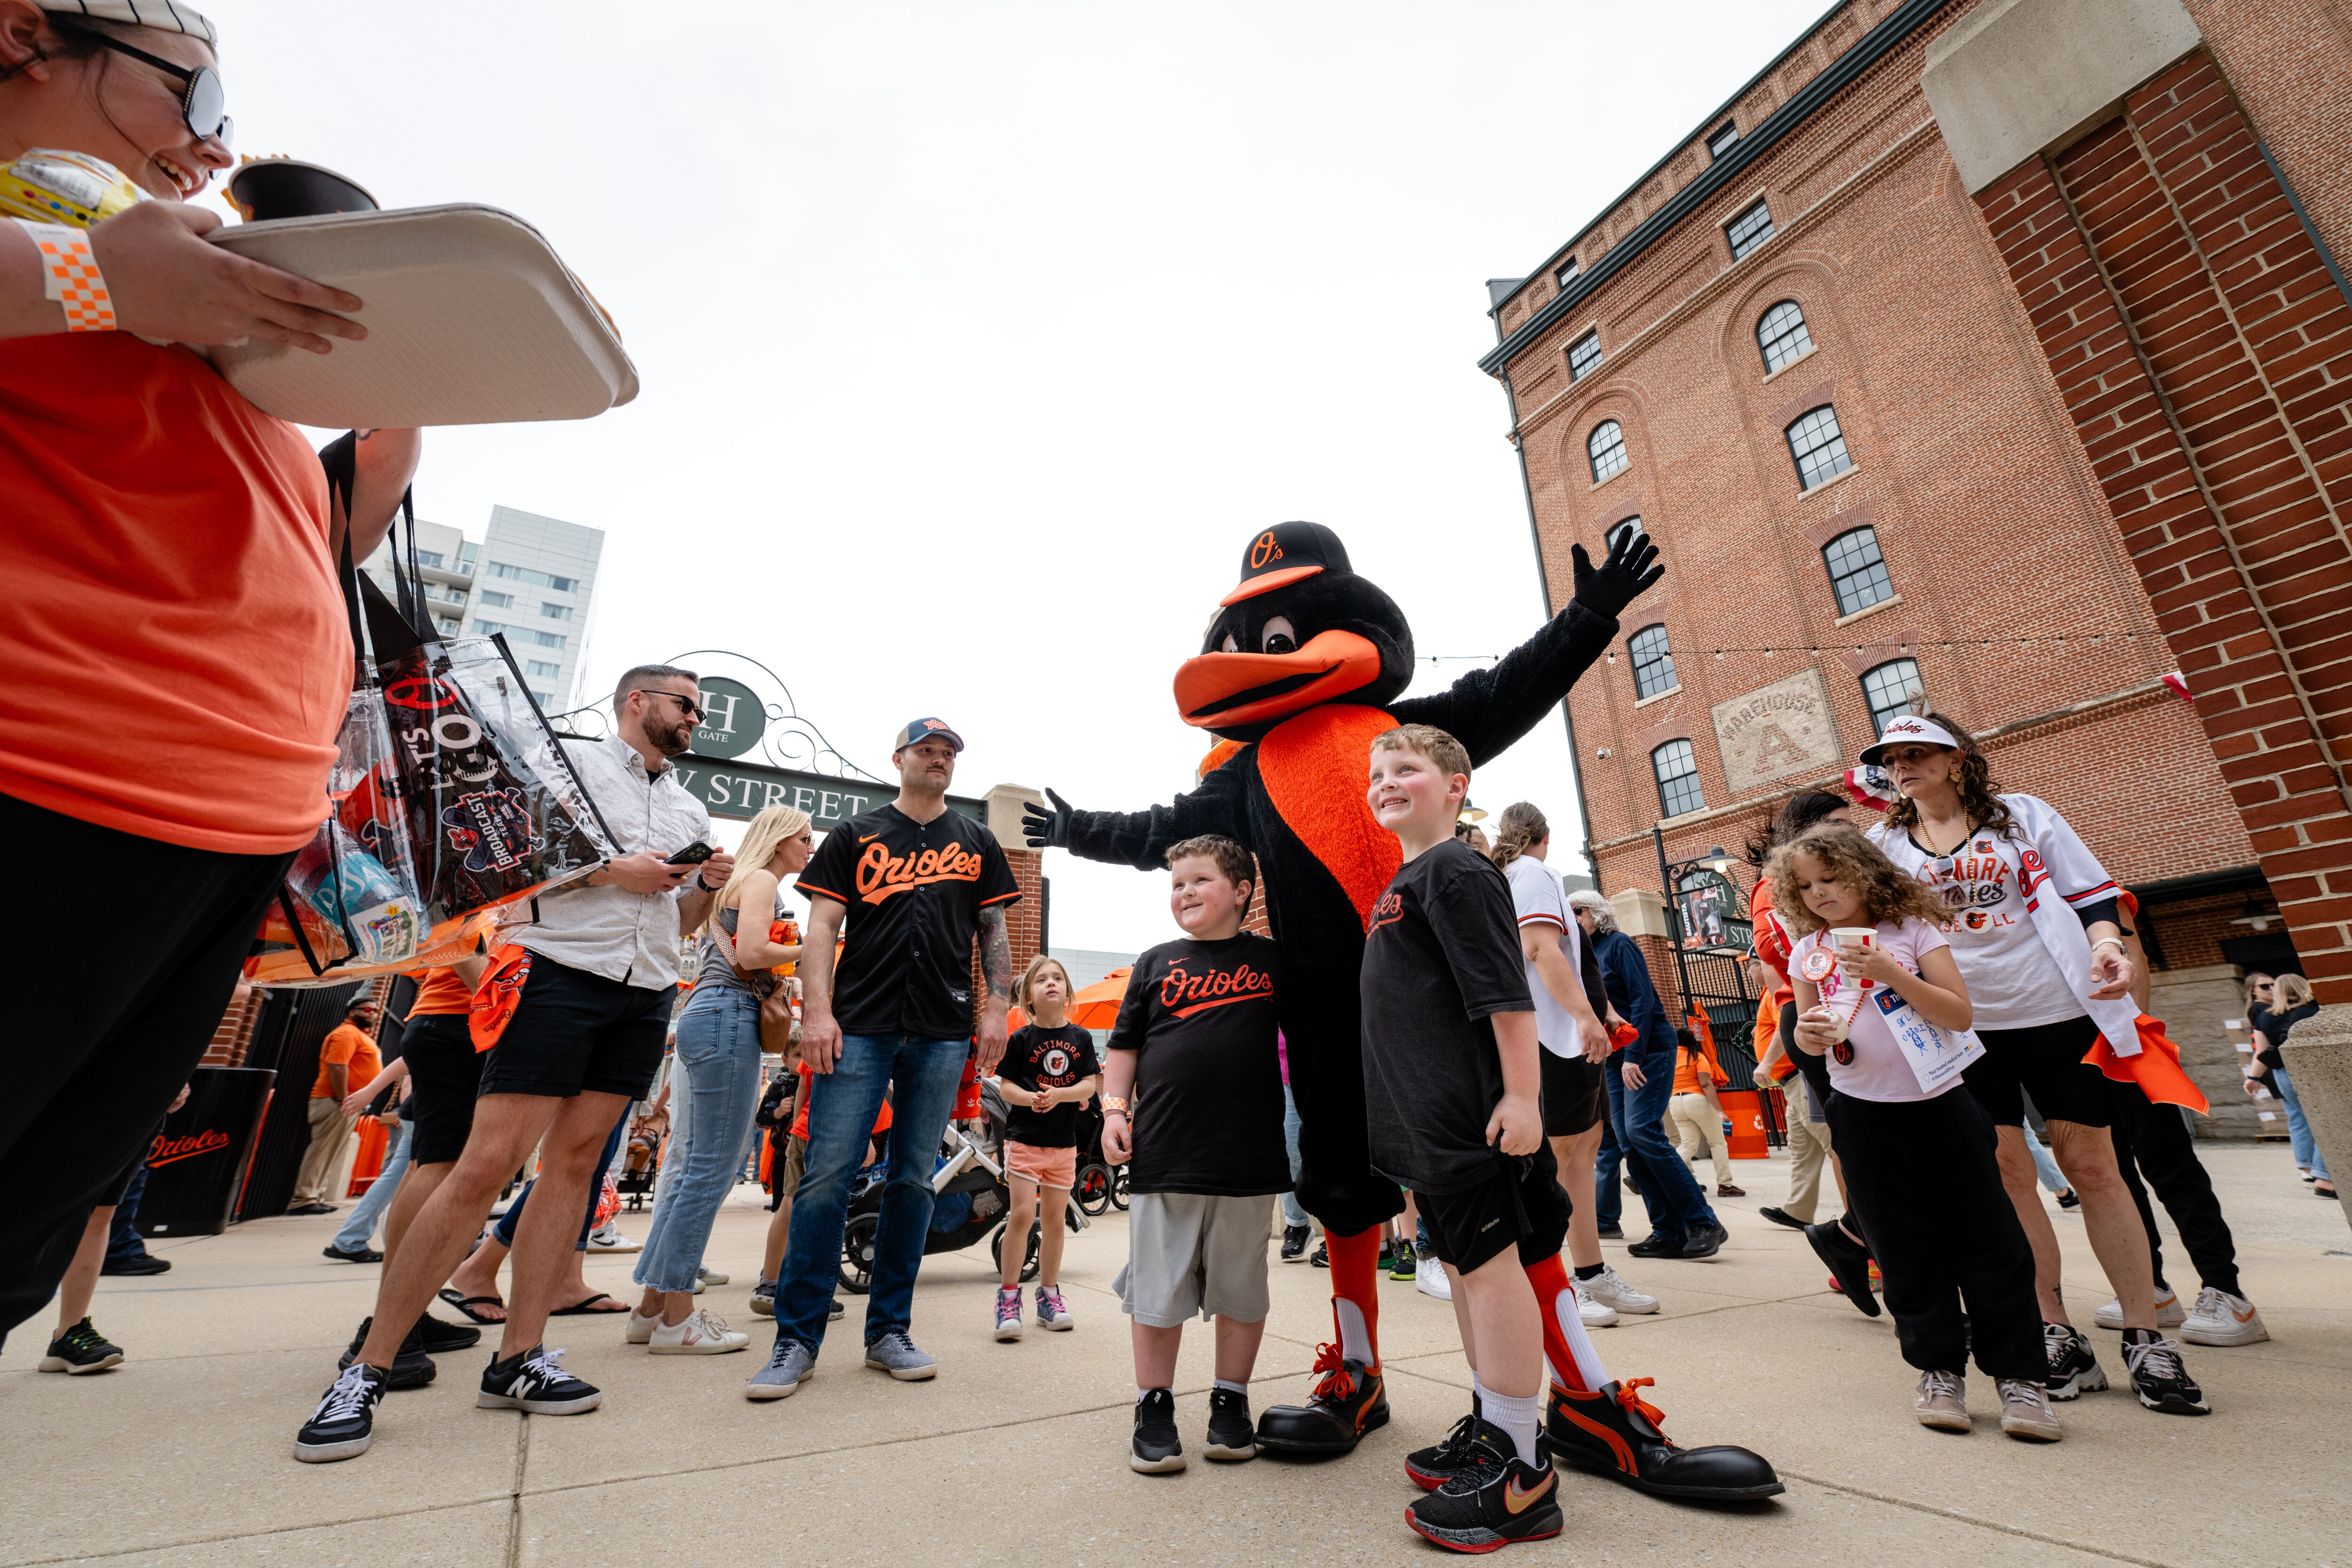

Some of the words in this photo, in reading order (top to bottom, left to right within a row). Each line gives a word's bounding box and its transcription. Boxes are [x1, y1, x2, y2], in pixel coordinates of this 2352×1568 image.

[1251, 531, 1283, 569] O's
[699, 691, 741, 733] H
[699, 731, 728, 742] GATE
[1753, 722, 1811, 775] A
[707, 774, 868, 820] STREET
[467, 797, 514, 866] BROADCAST
[493, 814, 509, 837] TEAM
[856, 842, 982, 899] Orioles
[1681, 903, 1692, 937] BAUTISTA
[1731, 925, 1754, 944] STR
[1806, 947, 1819, 956] TODAY
[1824, 959, 1833, 973] GAME!
[1161, 964, 1273, 1008] Orioles
[1030, 1040, 1081, 1063] BALTIMORE
[1936, 1061, 1947, 1072] trusted
[1947, 1054, 1957, 1065] medical
[1036, 1071, 1075, 1087] ORIOLES
[147, 1129, 230, 1162] Orioles
